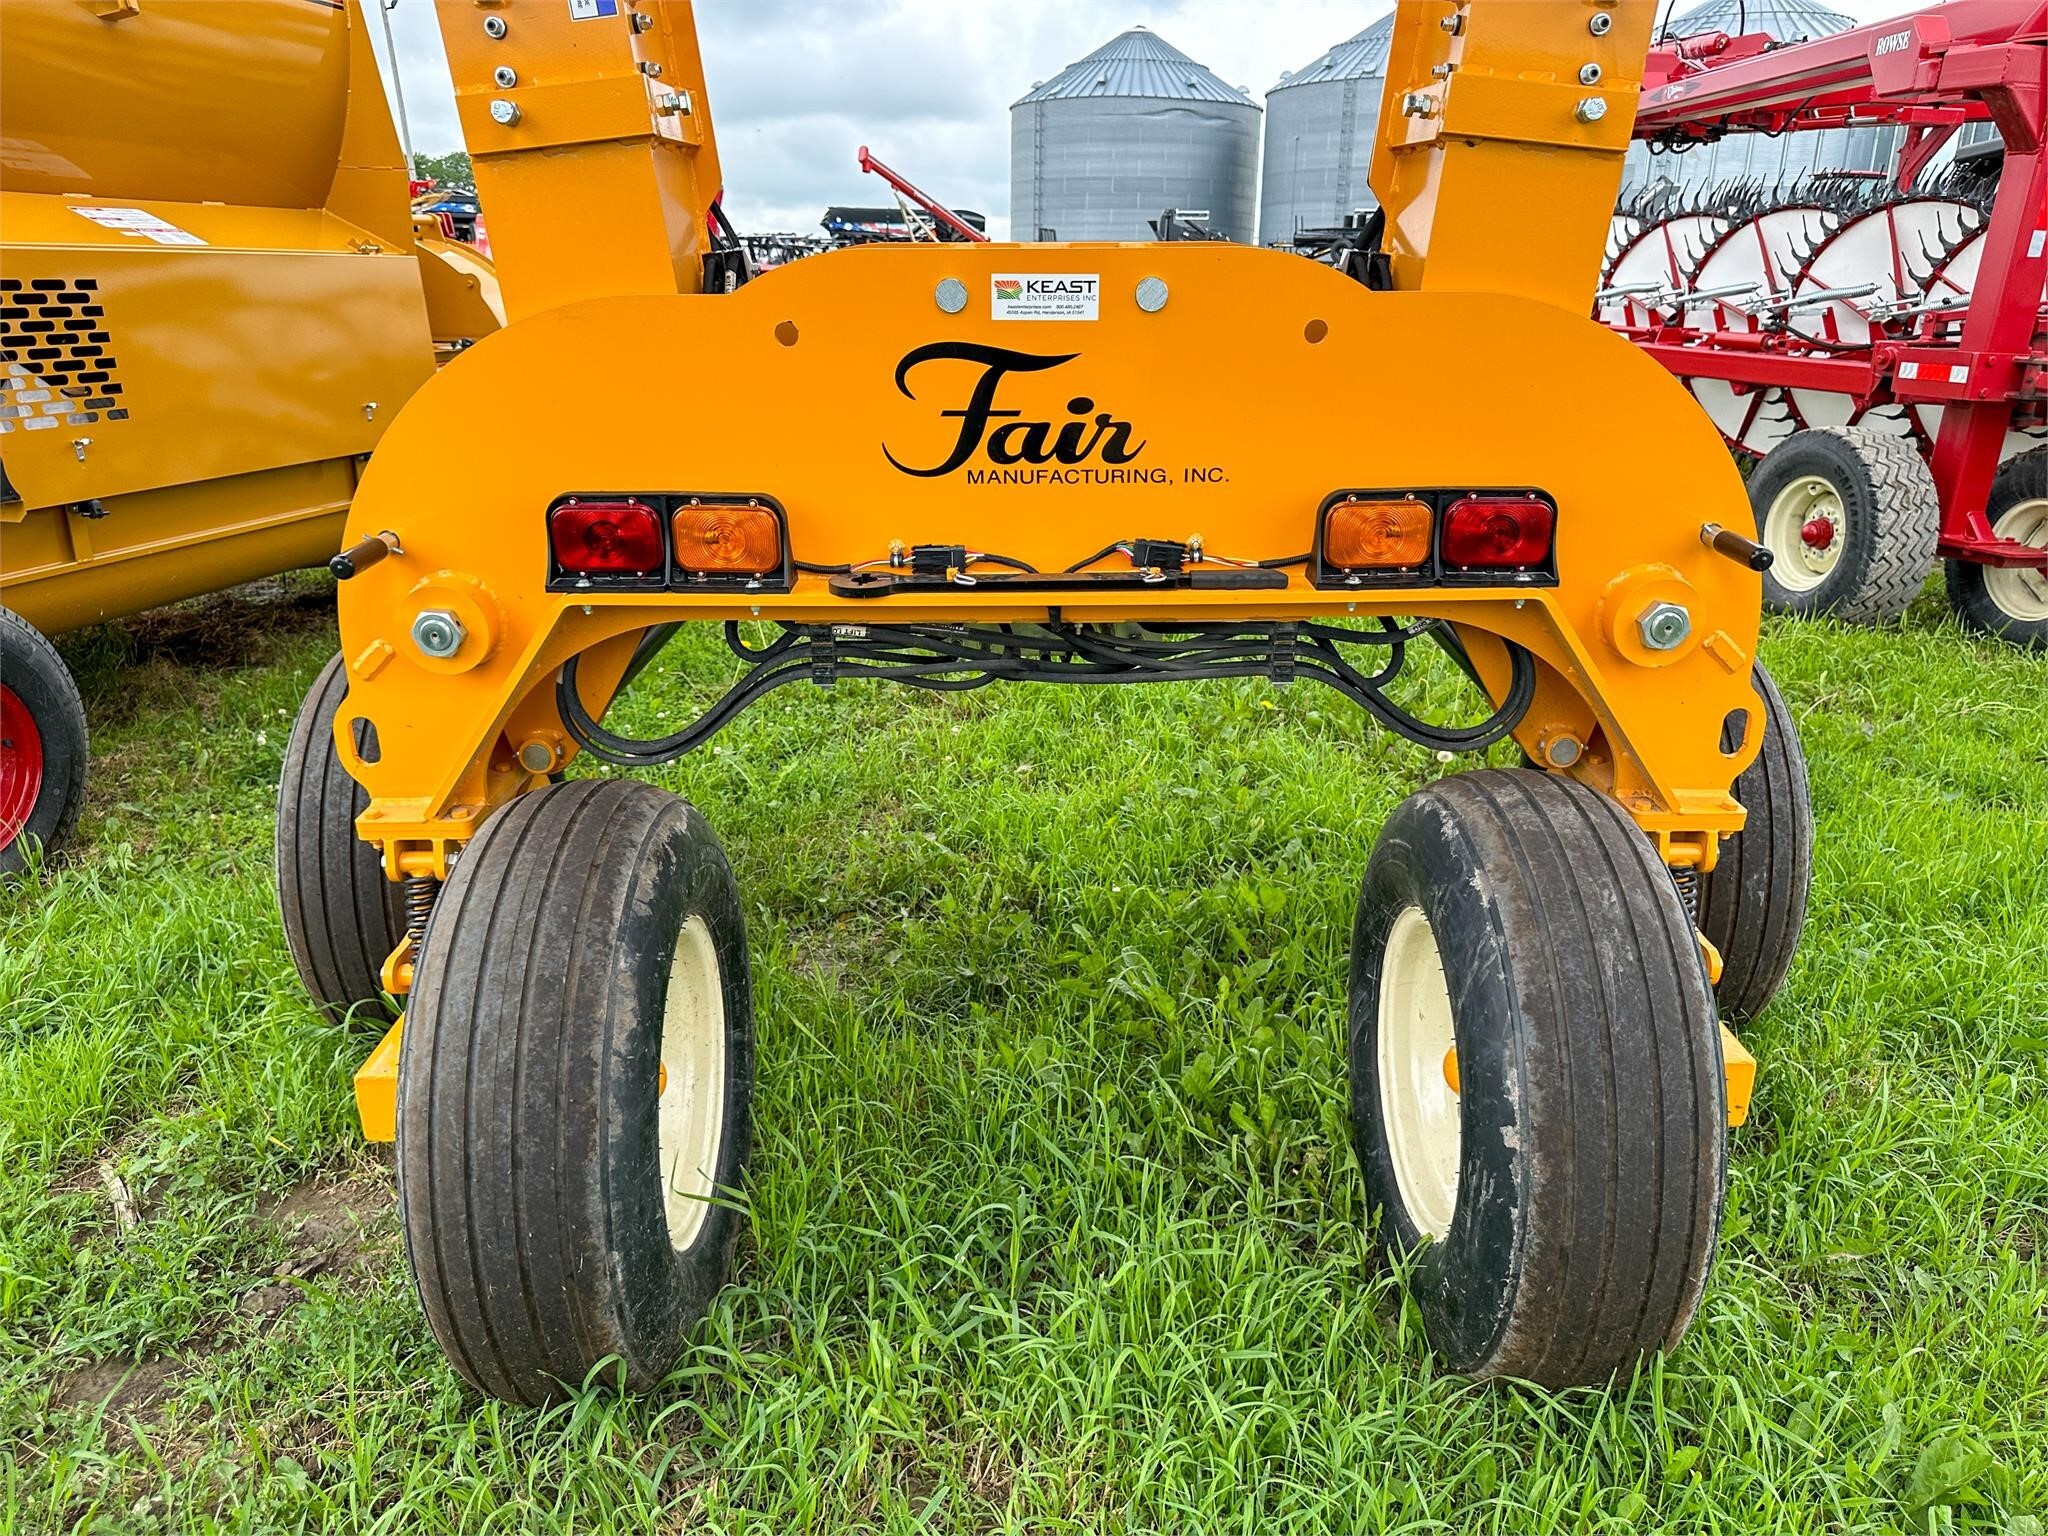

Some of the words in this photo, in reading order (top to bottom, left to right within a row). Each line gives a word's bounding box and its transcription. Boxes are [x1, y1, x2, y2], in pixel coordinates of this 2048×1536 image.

[1875, 30, 1911, 56] ROWSE
[1027, 280, 1097, 293] KEAST
[1027, 294, 1080, 302] ENTERPRISES
[1083, 294, 1097, 302] INC
[882, 341, 1147, 478] Fair
[967, 468, 1174, 486] MANUFACTURING,
[1184, 467, 1231, 484] INC.
